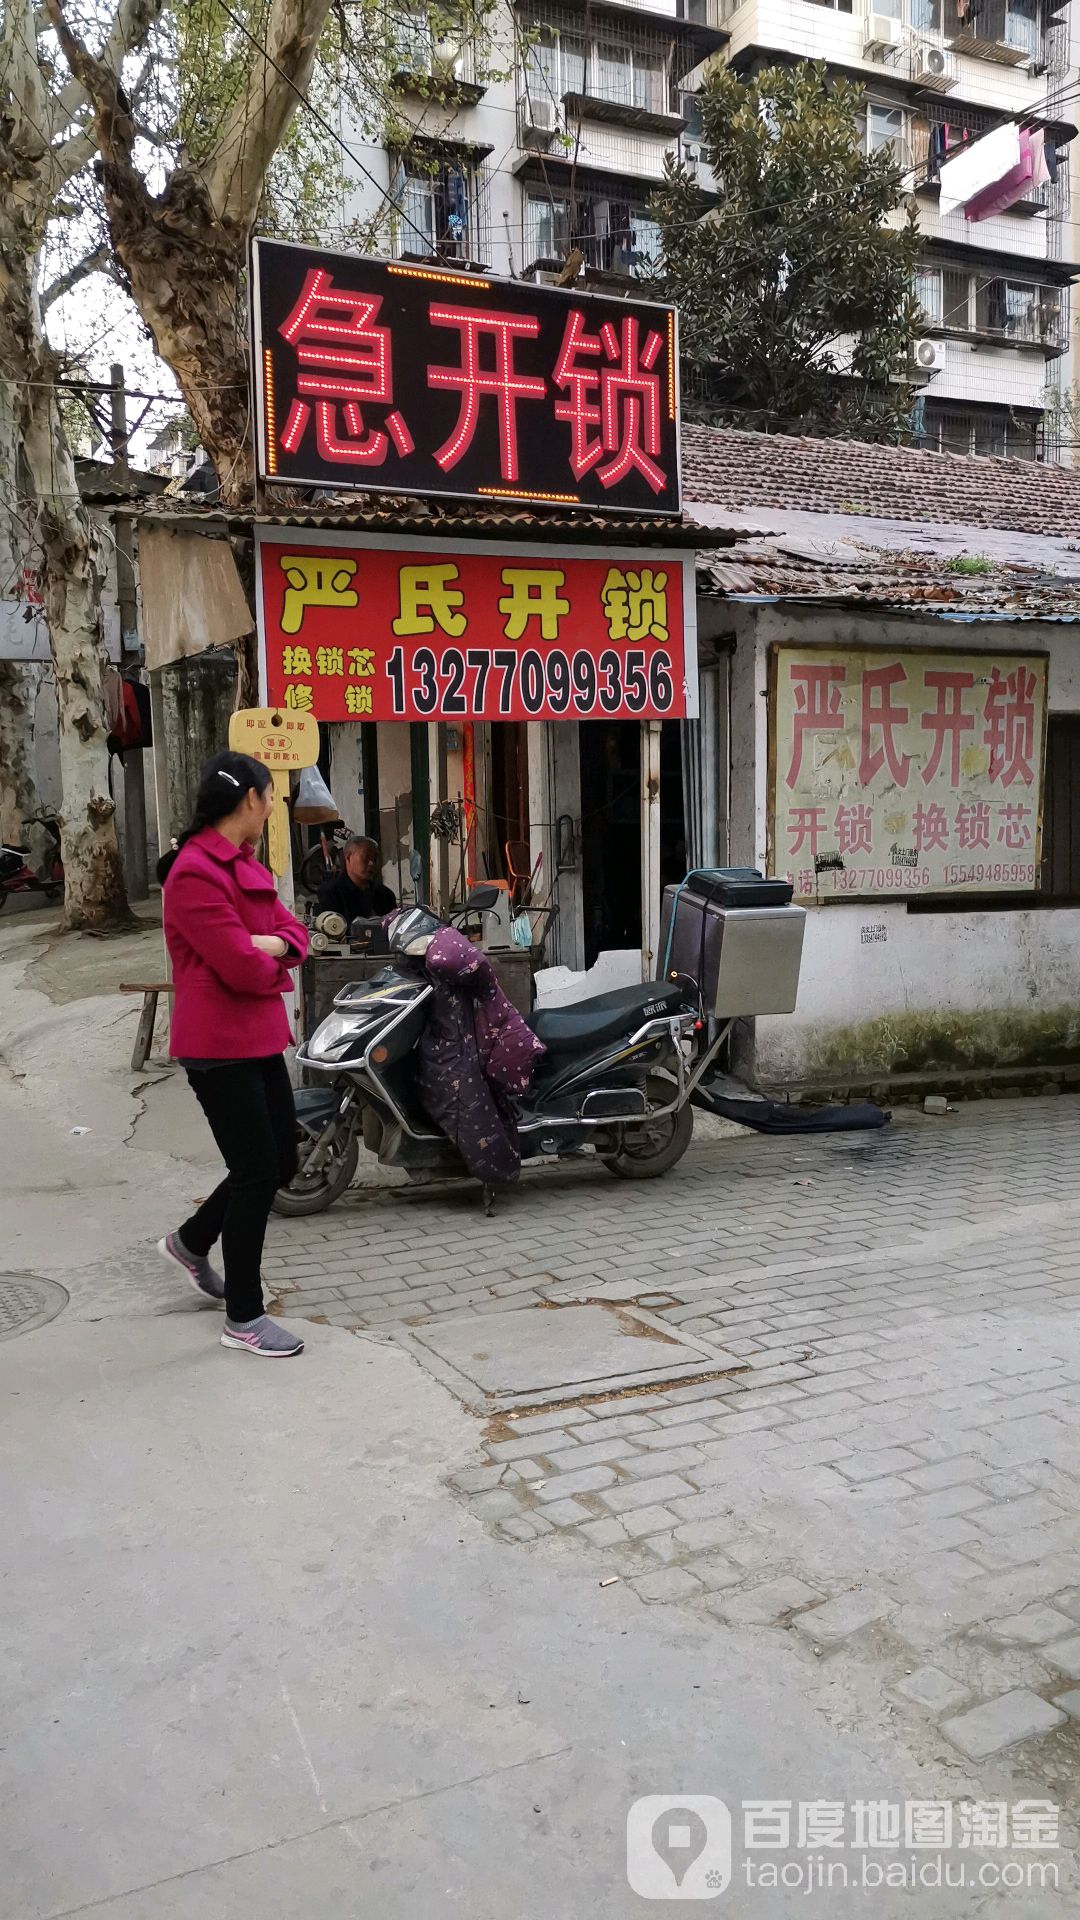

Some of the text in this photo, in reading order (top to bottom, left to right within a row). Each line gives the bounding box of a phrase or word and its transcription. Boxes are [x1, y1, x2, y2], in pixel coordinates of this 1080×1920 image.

[278, 268, 668, 495] 急开锁
[280, 555, 669, 642] 严氏开锁
[282, 645, 376, 677] 换锁芯
[386, 647, 673, 714] 13277099356
[284, 683, 374, 714] 修锁
[785, 662, 1037, 789] 严氏开锁
[787, 803, 1031, 856] 开锁 换锁芯
[832, 867, 930, 890] 13277099356
[943, 864, 1034, 884] 15549485958
